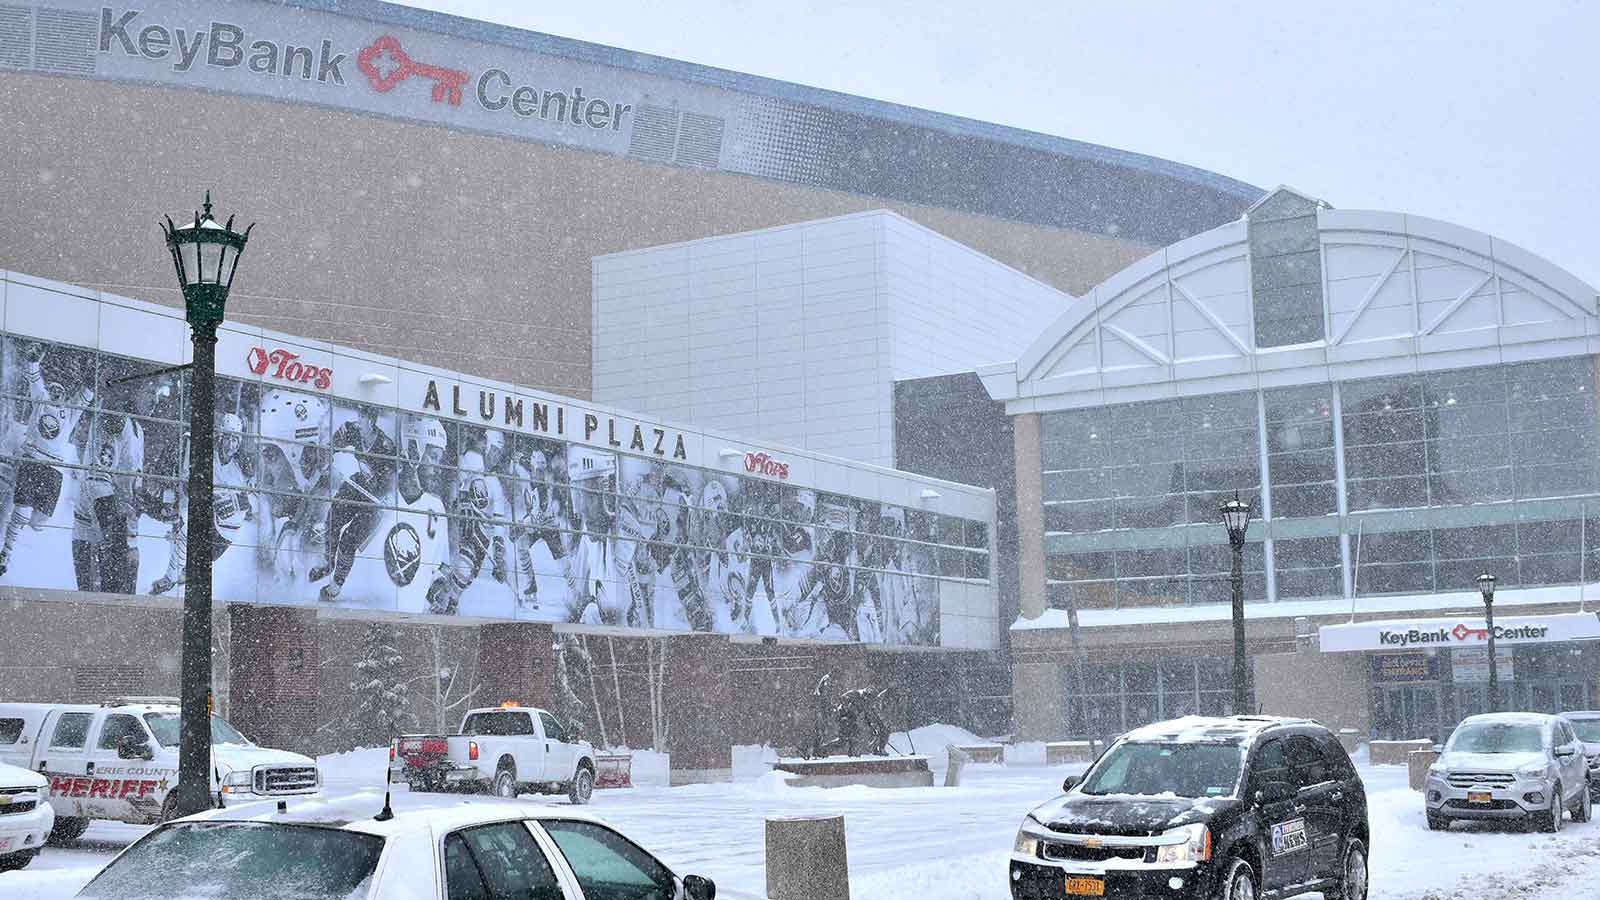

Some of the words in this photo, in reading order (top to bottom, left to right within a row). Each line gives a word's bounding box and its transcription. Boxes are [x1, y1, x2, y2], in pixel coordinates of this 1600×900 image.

[99, 7, 348, 87] KeyBank
[476, 68, 633, 132] Center
[423, 380, 565, 435] ALUMNI
[584, 413, 687, 460] PLAZA
[1380, 627, 1450, 646] KeyBank
[1493, 624, 1548, 640] Center
[96, 767, 126, 775] ERIE
[127, 767, 179, 776] COUNTY
[49, 776, 158, 799] HERIFF
